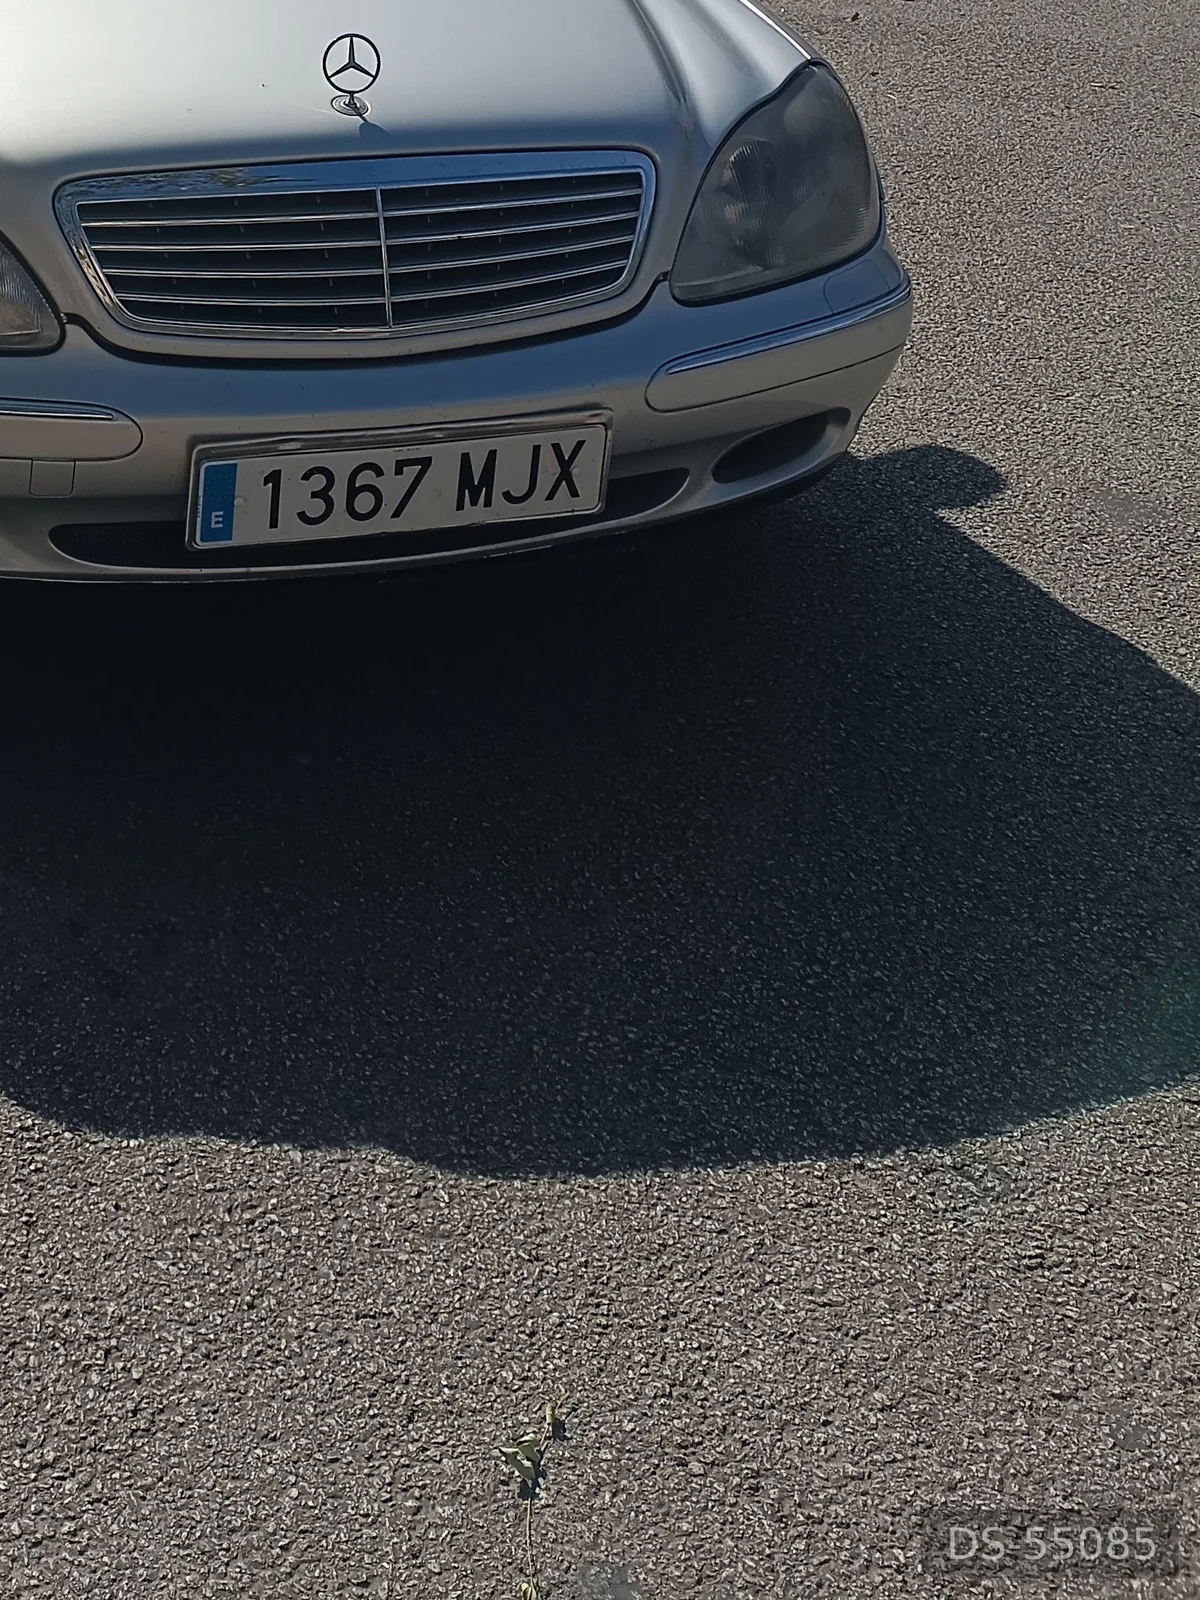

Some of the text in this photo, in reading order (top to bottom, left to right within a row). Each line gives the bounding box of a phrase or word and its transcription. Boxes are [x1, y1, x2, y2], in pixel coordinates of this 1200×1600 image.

[211, 439, 587, 530] E 1367 MJX
